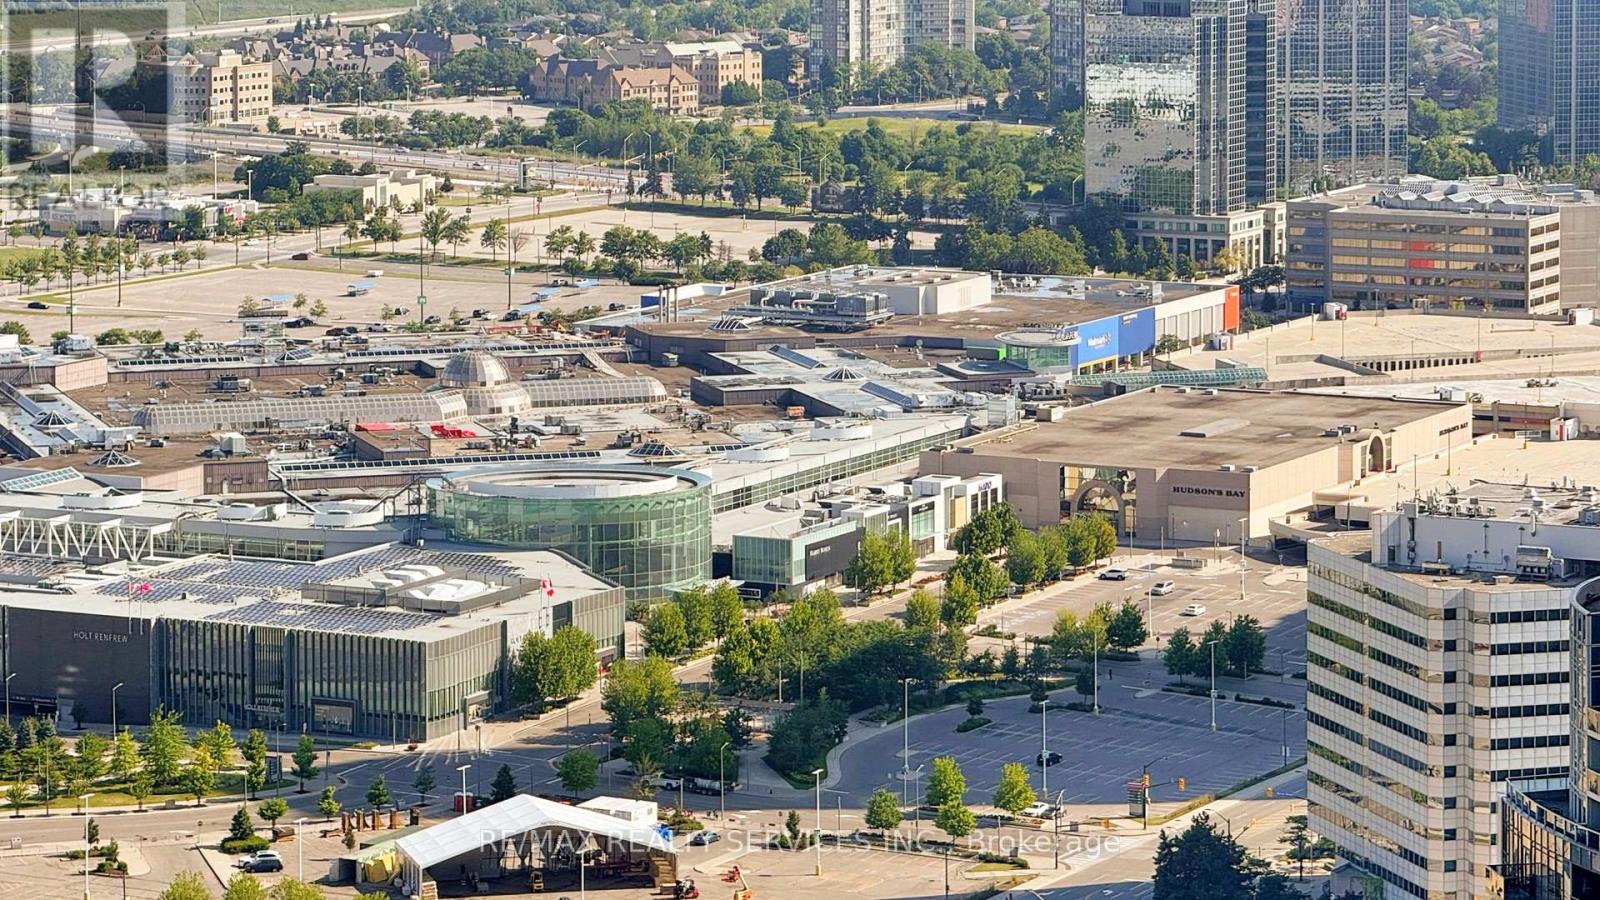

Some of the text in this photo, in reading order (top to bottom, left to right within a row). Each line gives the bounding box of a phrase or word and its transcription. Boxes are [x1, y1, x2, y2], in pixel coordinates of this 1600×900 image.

[1172, 486, 1246, 498] HUDSON'S BAY
[73, 630, 128, 643] HOLT RENFREW
